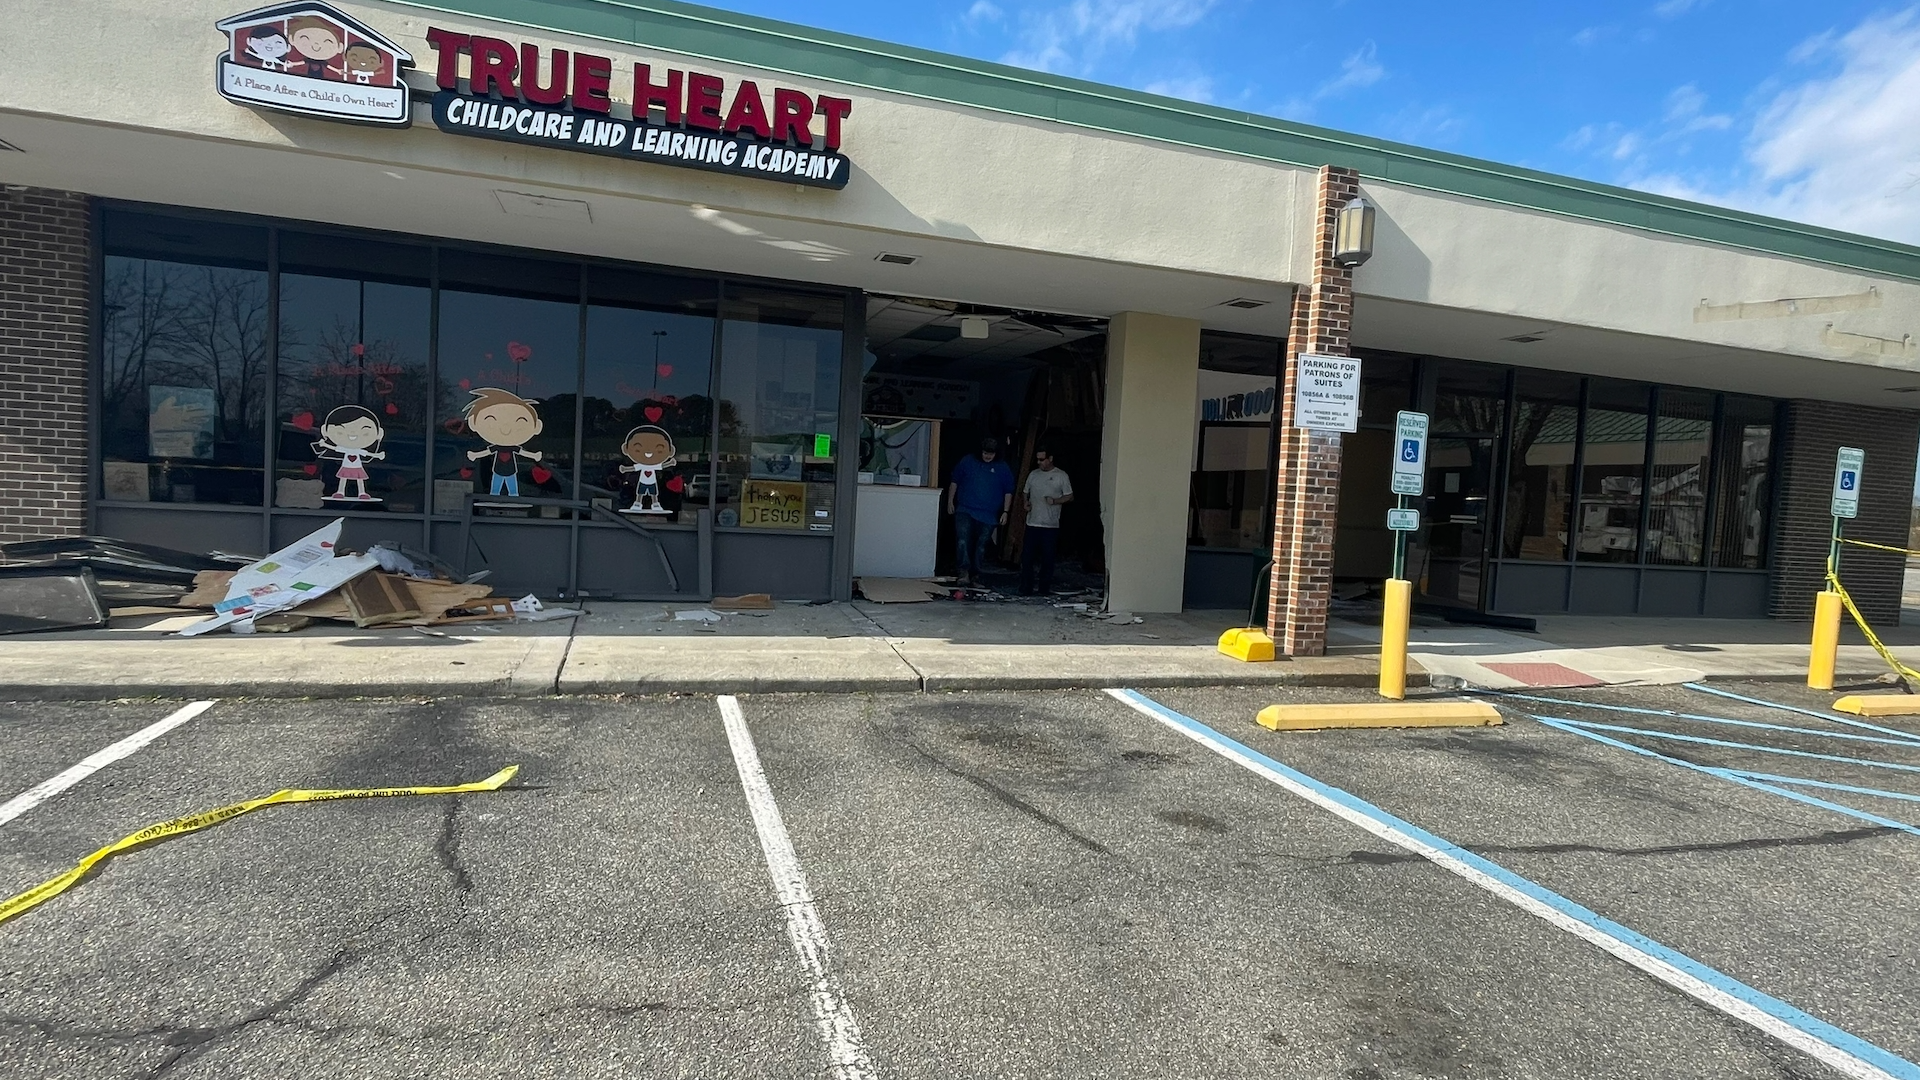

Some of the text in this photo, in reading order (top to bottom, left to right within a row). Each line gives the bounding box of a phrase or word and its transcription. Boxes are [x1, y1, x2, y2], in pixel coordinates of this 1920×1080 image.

[245, 78, 272, 92] Place
[273, 84, 299, 97] After
[308, 90, 341, 103] Child's
[342, 94, 365, 106] Own
[426, 26, 852, 151] TRUE HEART
[446, 97, 840, 180] CHILDCARE AND LEARNING ACADEMY
[1303, 360, 1356, 371] PARKING FOR
[1304, 369, 1353, 380] PATRONS OF
[1314, 379, 1343, 388] SUITES
[1400, 417, 1426, 429] RESERVED
[1400, 428, 1424, 438] PARKING
[746, 506, 801, 524] JESUS
